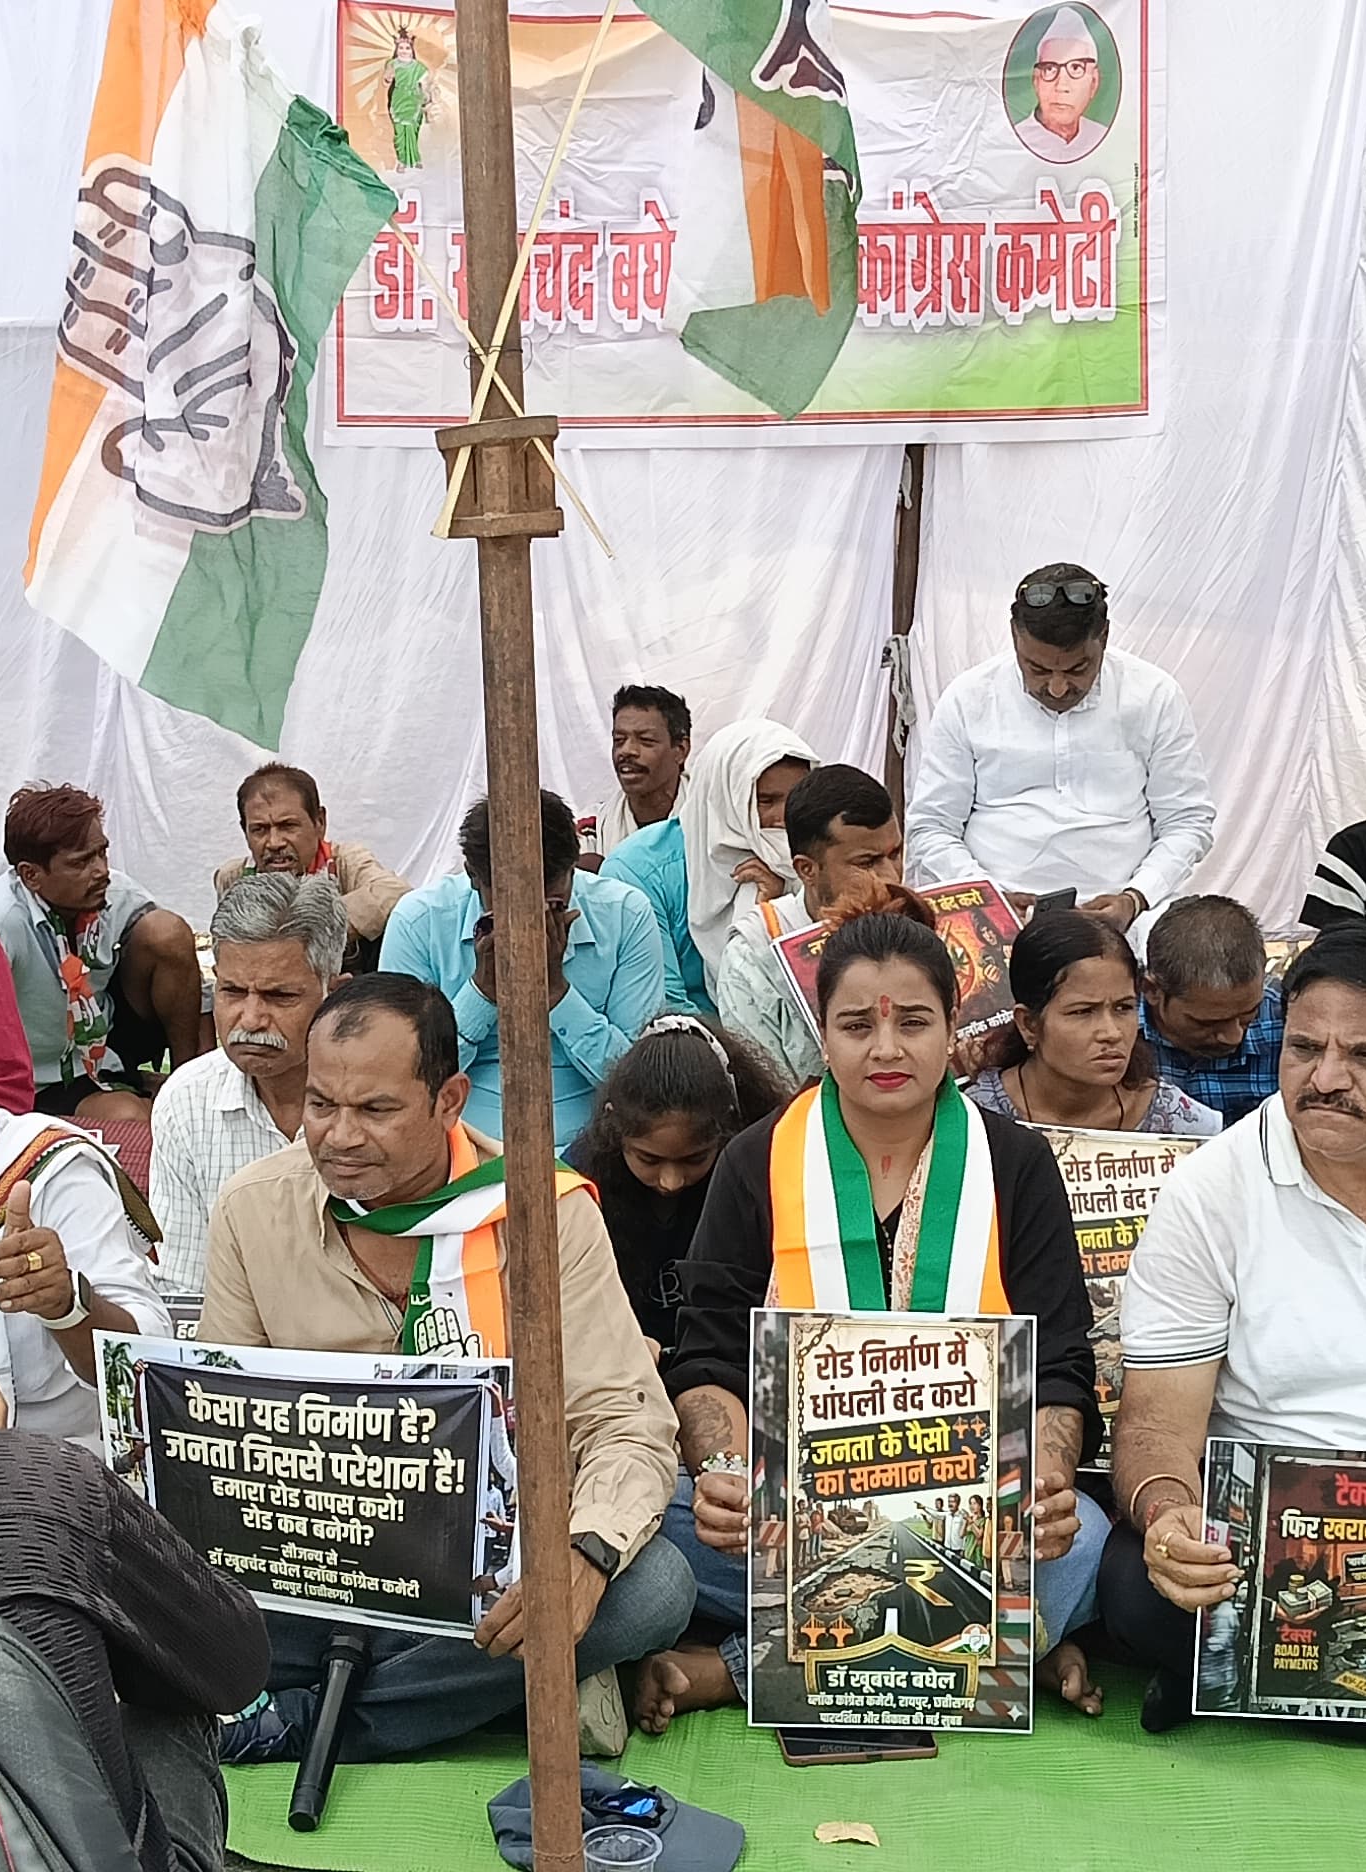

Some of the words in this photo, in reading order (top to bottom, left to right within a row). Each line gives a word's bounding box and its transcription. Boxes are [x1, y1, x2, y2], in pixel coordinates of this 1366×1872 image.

[610, 200, 677, 320] बघे
[858, 191, 985, 318] कांग्रेस
[995, 190, 1116, 312] कमेटी
[960, 888, 984, 908] करो
[1064, 1155, 1092, 1183] रोड
[1095, 1150, 1156, 1182] निर्माण
[1122, 1186, 1146, 1209] बंद
[1114, 1219, 1133, 1247] के
[814, 1343, 855, 1381] रोड
[859, 1334, 940, 1375] निर्माण
[942, 1331, 972, 1368] में
[185, 1380, 247, 1430] कैसा
[251, 1399, 293, 1433] यह
[295, 1391, 394, 1443] निर्माण
[398, 1397, 436, 1445] है?
[810, 1378, 885, 1421] धांधली
[893, 1382, 925, 1413] बंद
[930, 1372, 978, 1409] करो
[811, 1434, 875, 1466] जनता
[878, 1428, 903, 1460] के
[906, 1420, 952, 1455] पैसो
[161, 1428, 237, 1472] जनता
[241, 1430, 326, 1483] जिससे
[329, 1445, 429, 1493] परेशान
[434, 1446, 466, 1495] है!
[814, 1468, 845, 1497] का
[849, 1458, 927, 1492] सम्मान
[933, 1451, 977, 1483] करो
[210, 1475, 265, 1503] हमारा
[269, 1478, 301, 1509] रोड
[304, 1487, 355, 1516] वापस
[358, 1491, 404, 1521] करो!
[242, 1507, 274, 1531] रोड
[277, 1512, 307, 1538] कब
[310, 1512, 374, 1546] बनेगी?
[1281, 1509, 1321, 1540] फिर
[281, 1542, 325, 1564] सौजन्य
[325, 1548, 339, 1566] से
[207, 1547, 224, 1566] डॉ
[224, 1553, 268, 1574] खूबचंद
[269, 1557, 301, 1578] बघेल
[302, 1565, 339, 1584] ब्लॉक
[339, 1568, 380, 1592] कांग्रेस
[380, 1578, 420, 1598] कमेटी
[1273, 1658, 1319, 1671] PAYMENTS
[1274, 1644, 1300, 1657] ROAD
[1302, 1644, 1319, 1657] TAX
[826, 1666, 848, 1687] डॉ
[849, 1667, 909, 1693] खूबचंद
[911, 1667, 956, 1689] बघेल
[835, 1692, 864, 1707] कांग्रेस
[863, 1711, 880, 1724] और
[912, 1713, 924, 1725] की
